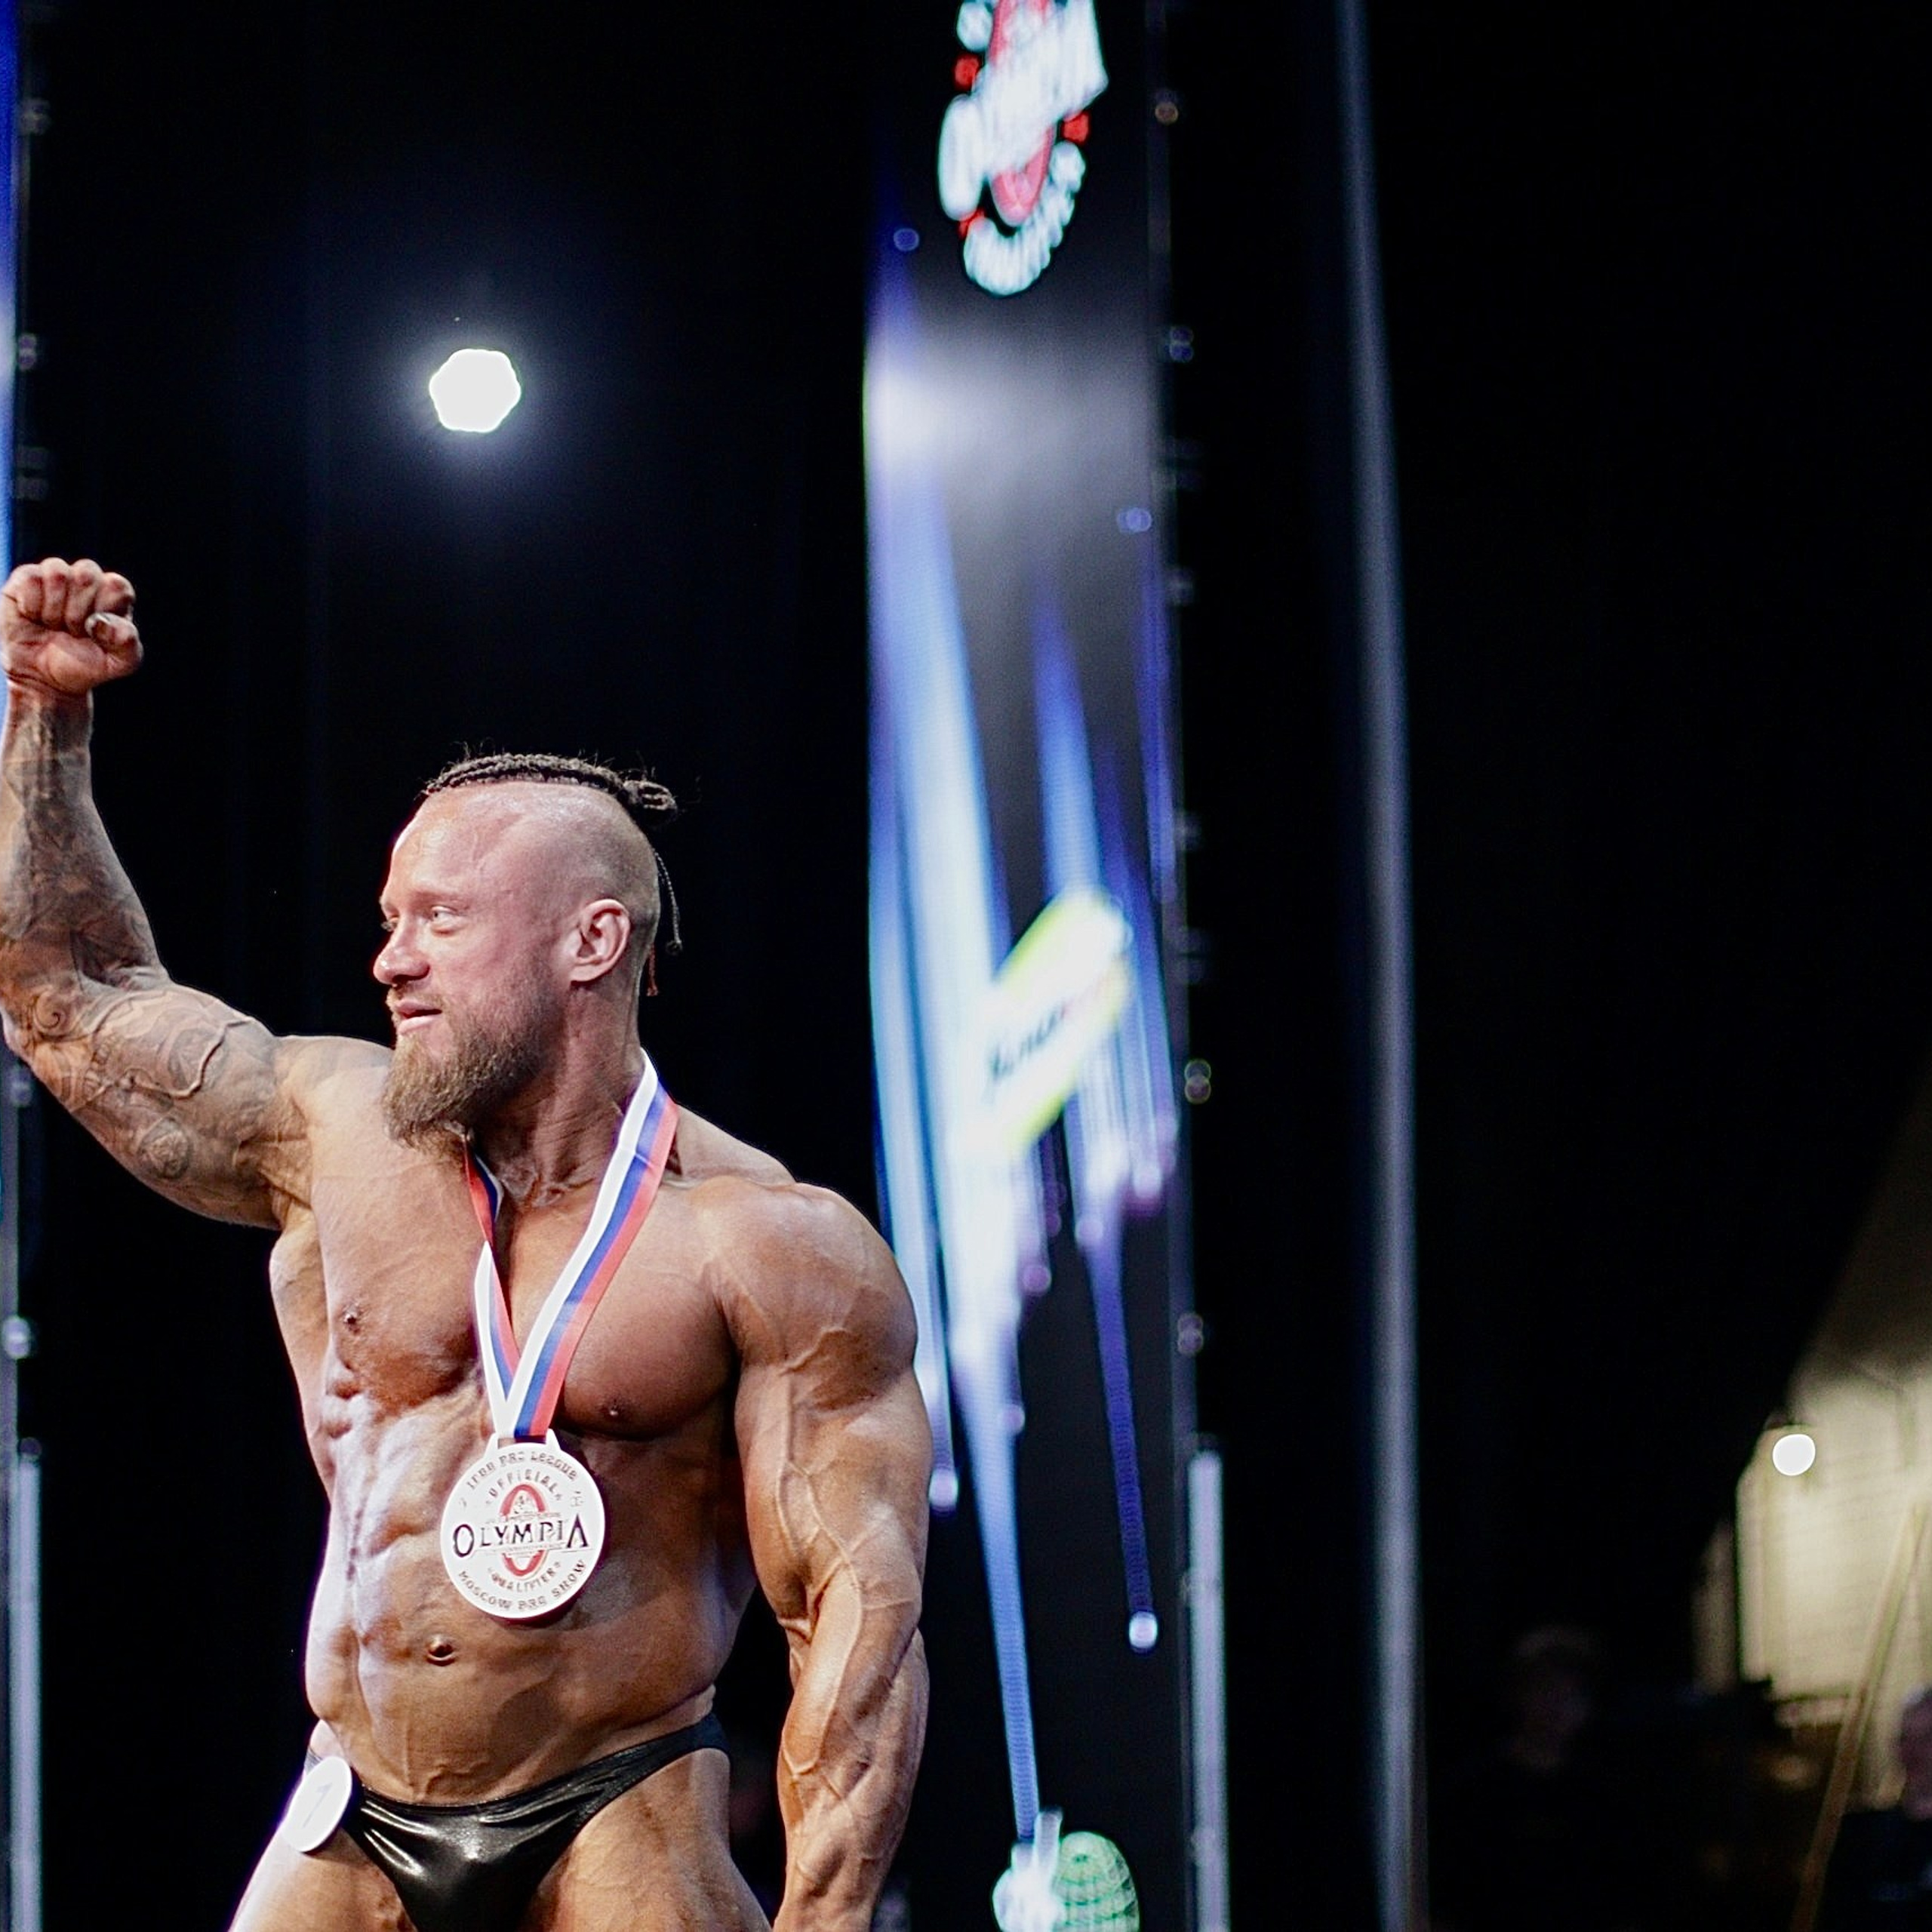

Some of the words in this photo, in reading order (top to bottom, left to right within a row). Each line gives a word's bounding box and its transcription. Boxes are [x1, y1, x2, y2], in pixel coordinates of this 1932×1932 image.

[453, 1513, 589, 1558] OLYMPIA
[458, 1571, 512, 1611] MOSCOW
[551, 1559, 586, 1598] SHOW
